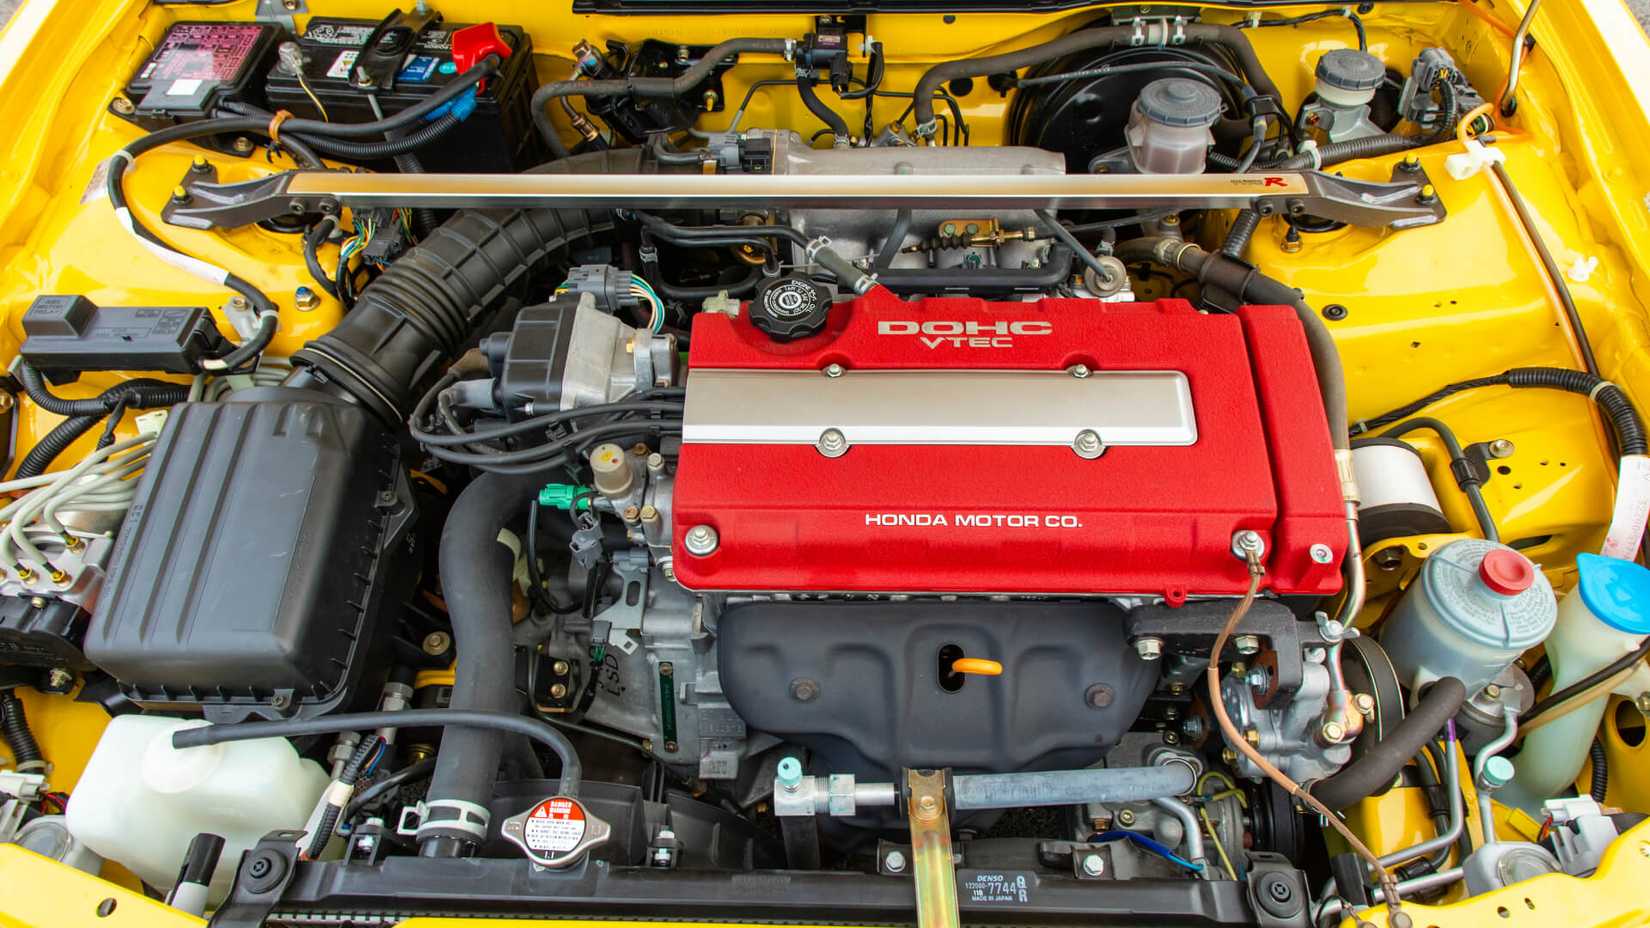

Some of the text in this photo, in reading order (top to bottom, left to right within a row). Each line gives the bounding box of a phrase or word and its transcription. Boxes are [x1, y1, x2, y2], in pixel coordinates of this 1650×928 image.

[1264, 176, 1288, 187] R
[877, 320, 1053, 336] DOHC
[920, 336, 1013, 350] VTEC
[865, 513, 1083, 528] HONDA MOTOR CO.
